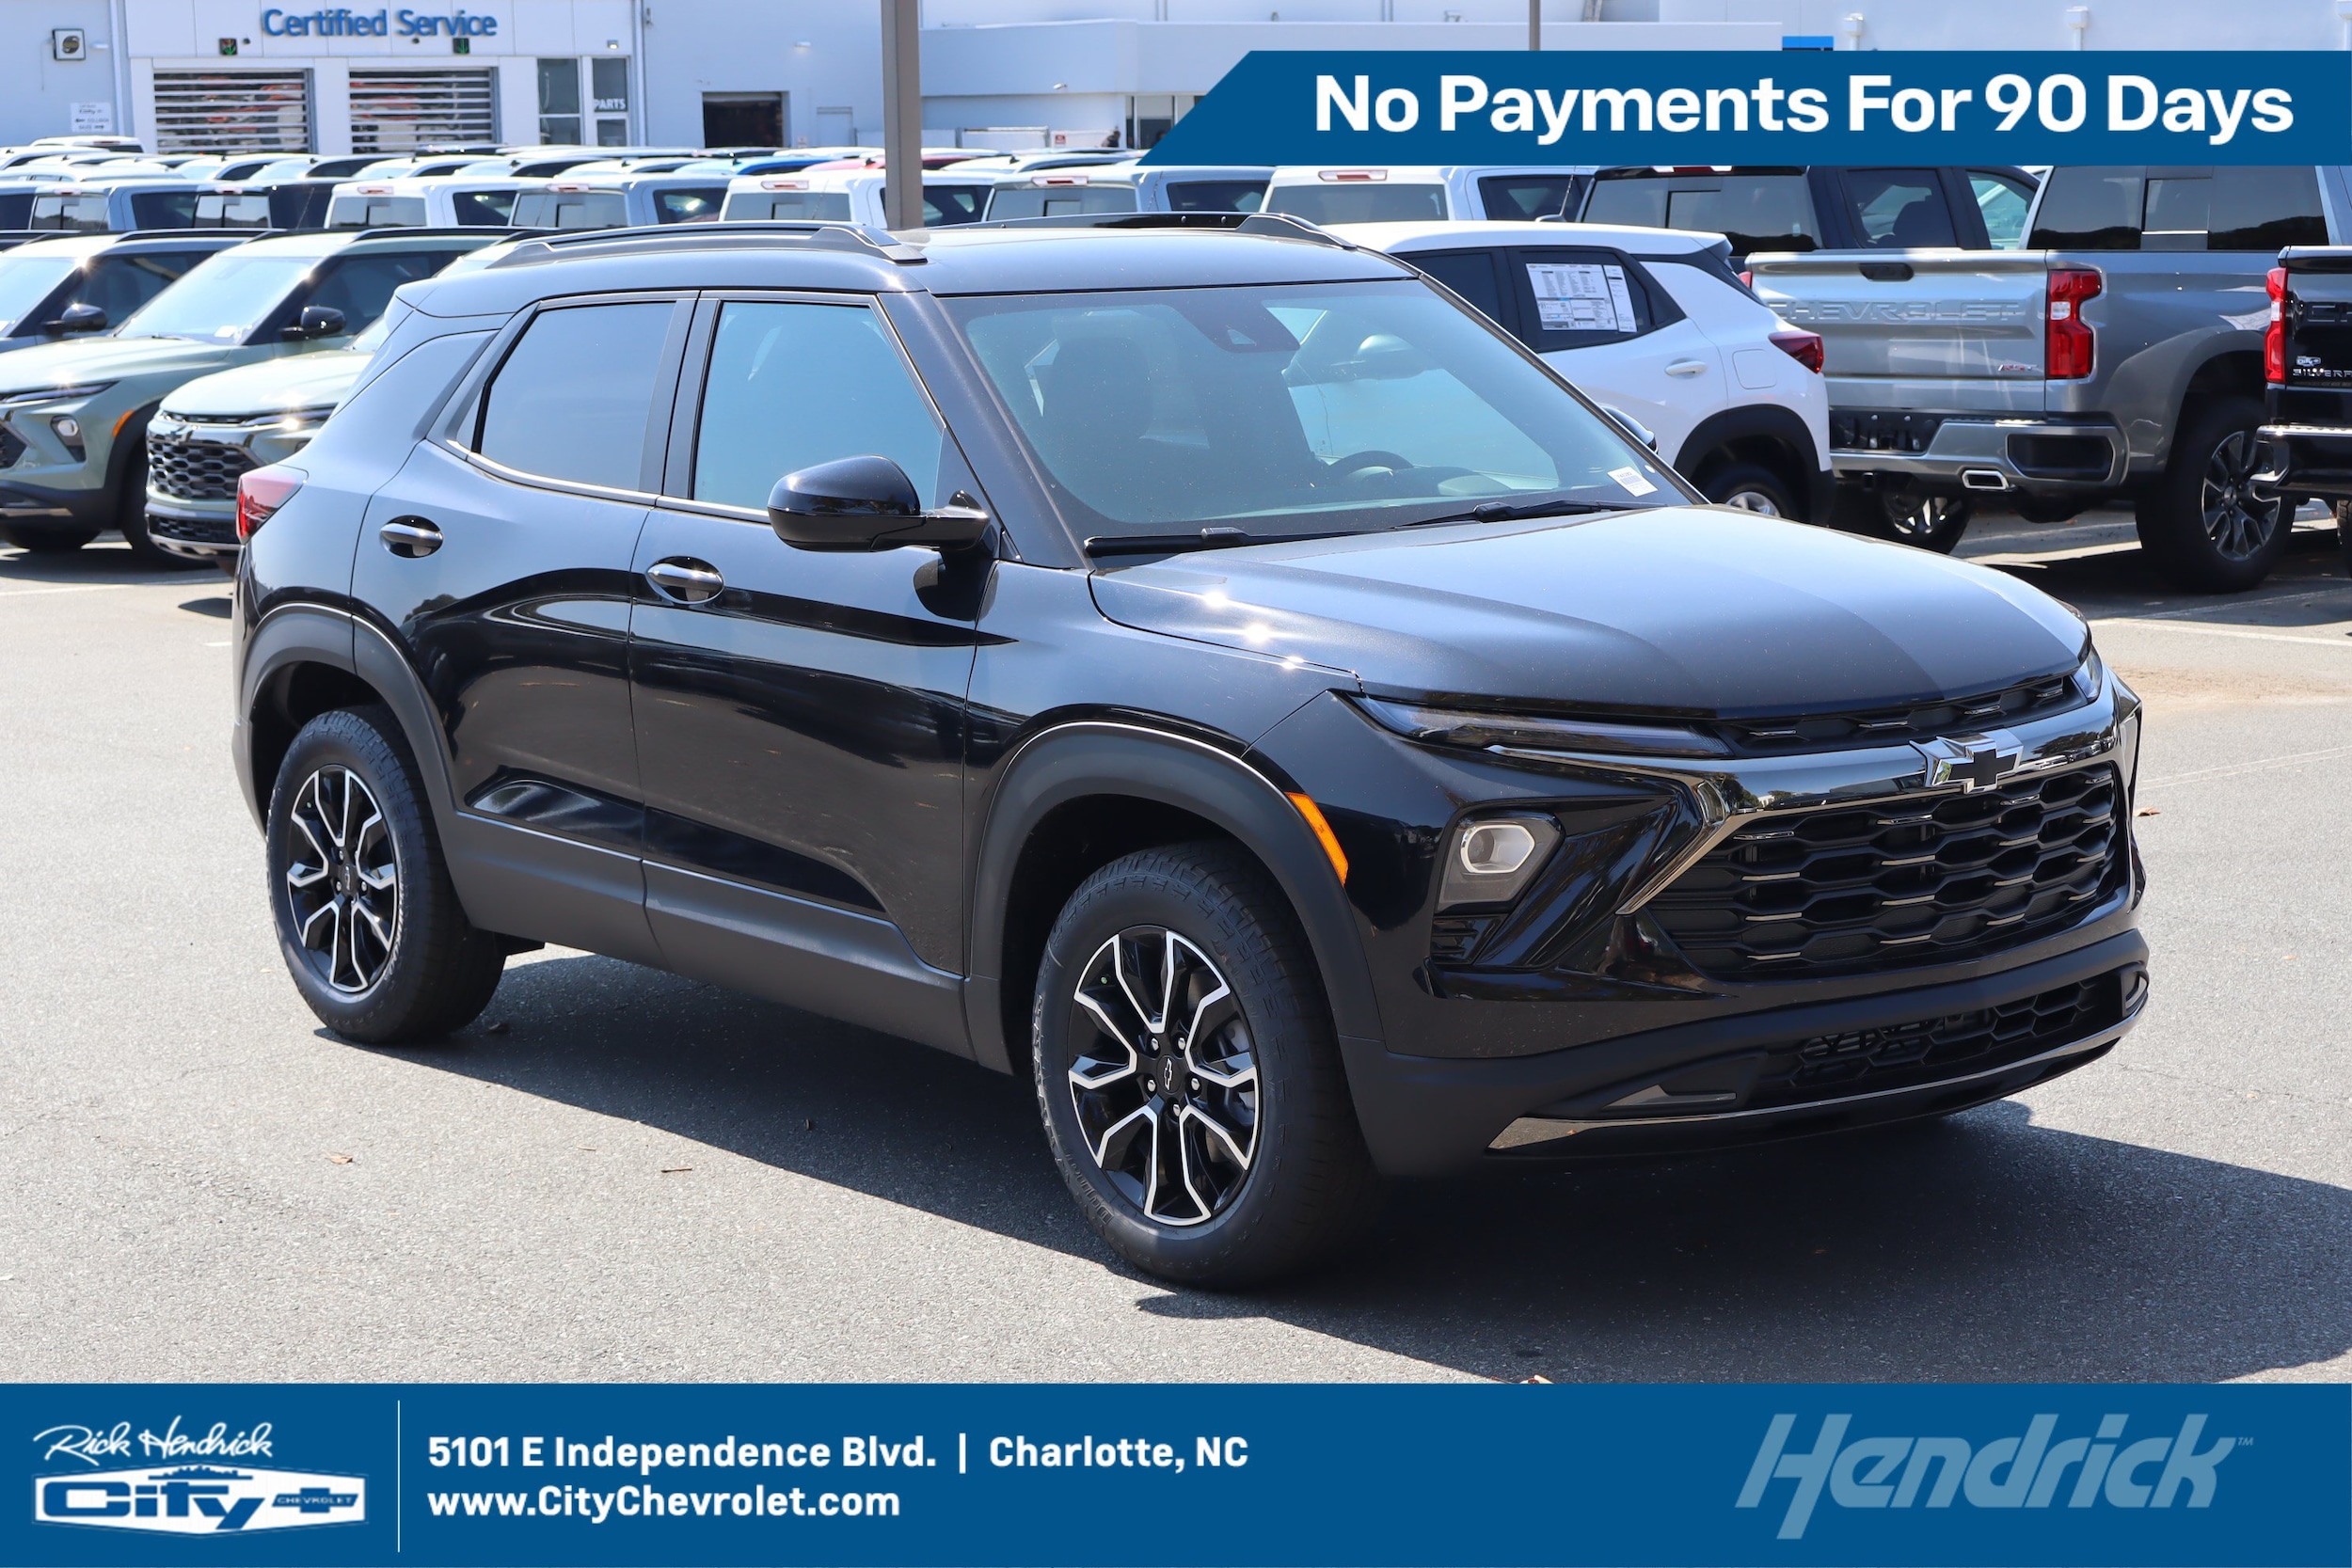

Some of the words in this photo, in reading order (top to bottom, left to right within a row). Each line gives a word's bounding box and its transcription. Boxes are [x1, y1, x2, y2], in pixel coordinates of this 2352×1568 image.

[263, 8, 388, 37] Certified
[397, 9, 498, 37] Service
[593, 98, 626, 110] PARTS
[1768, 301, 2020, 321] CHEVROLET
